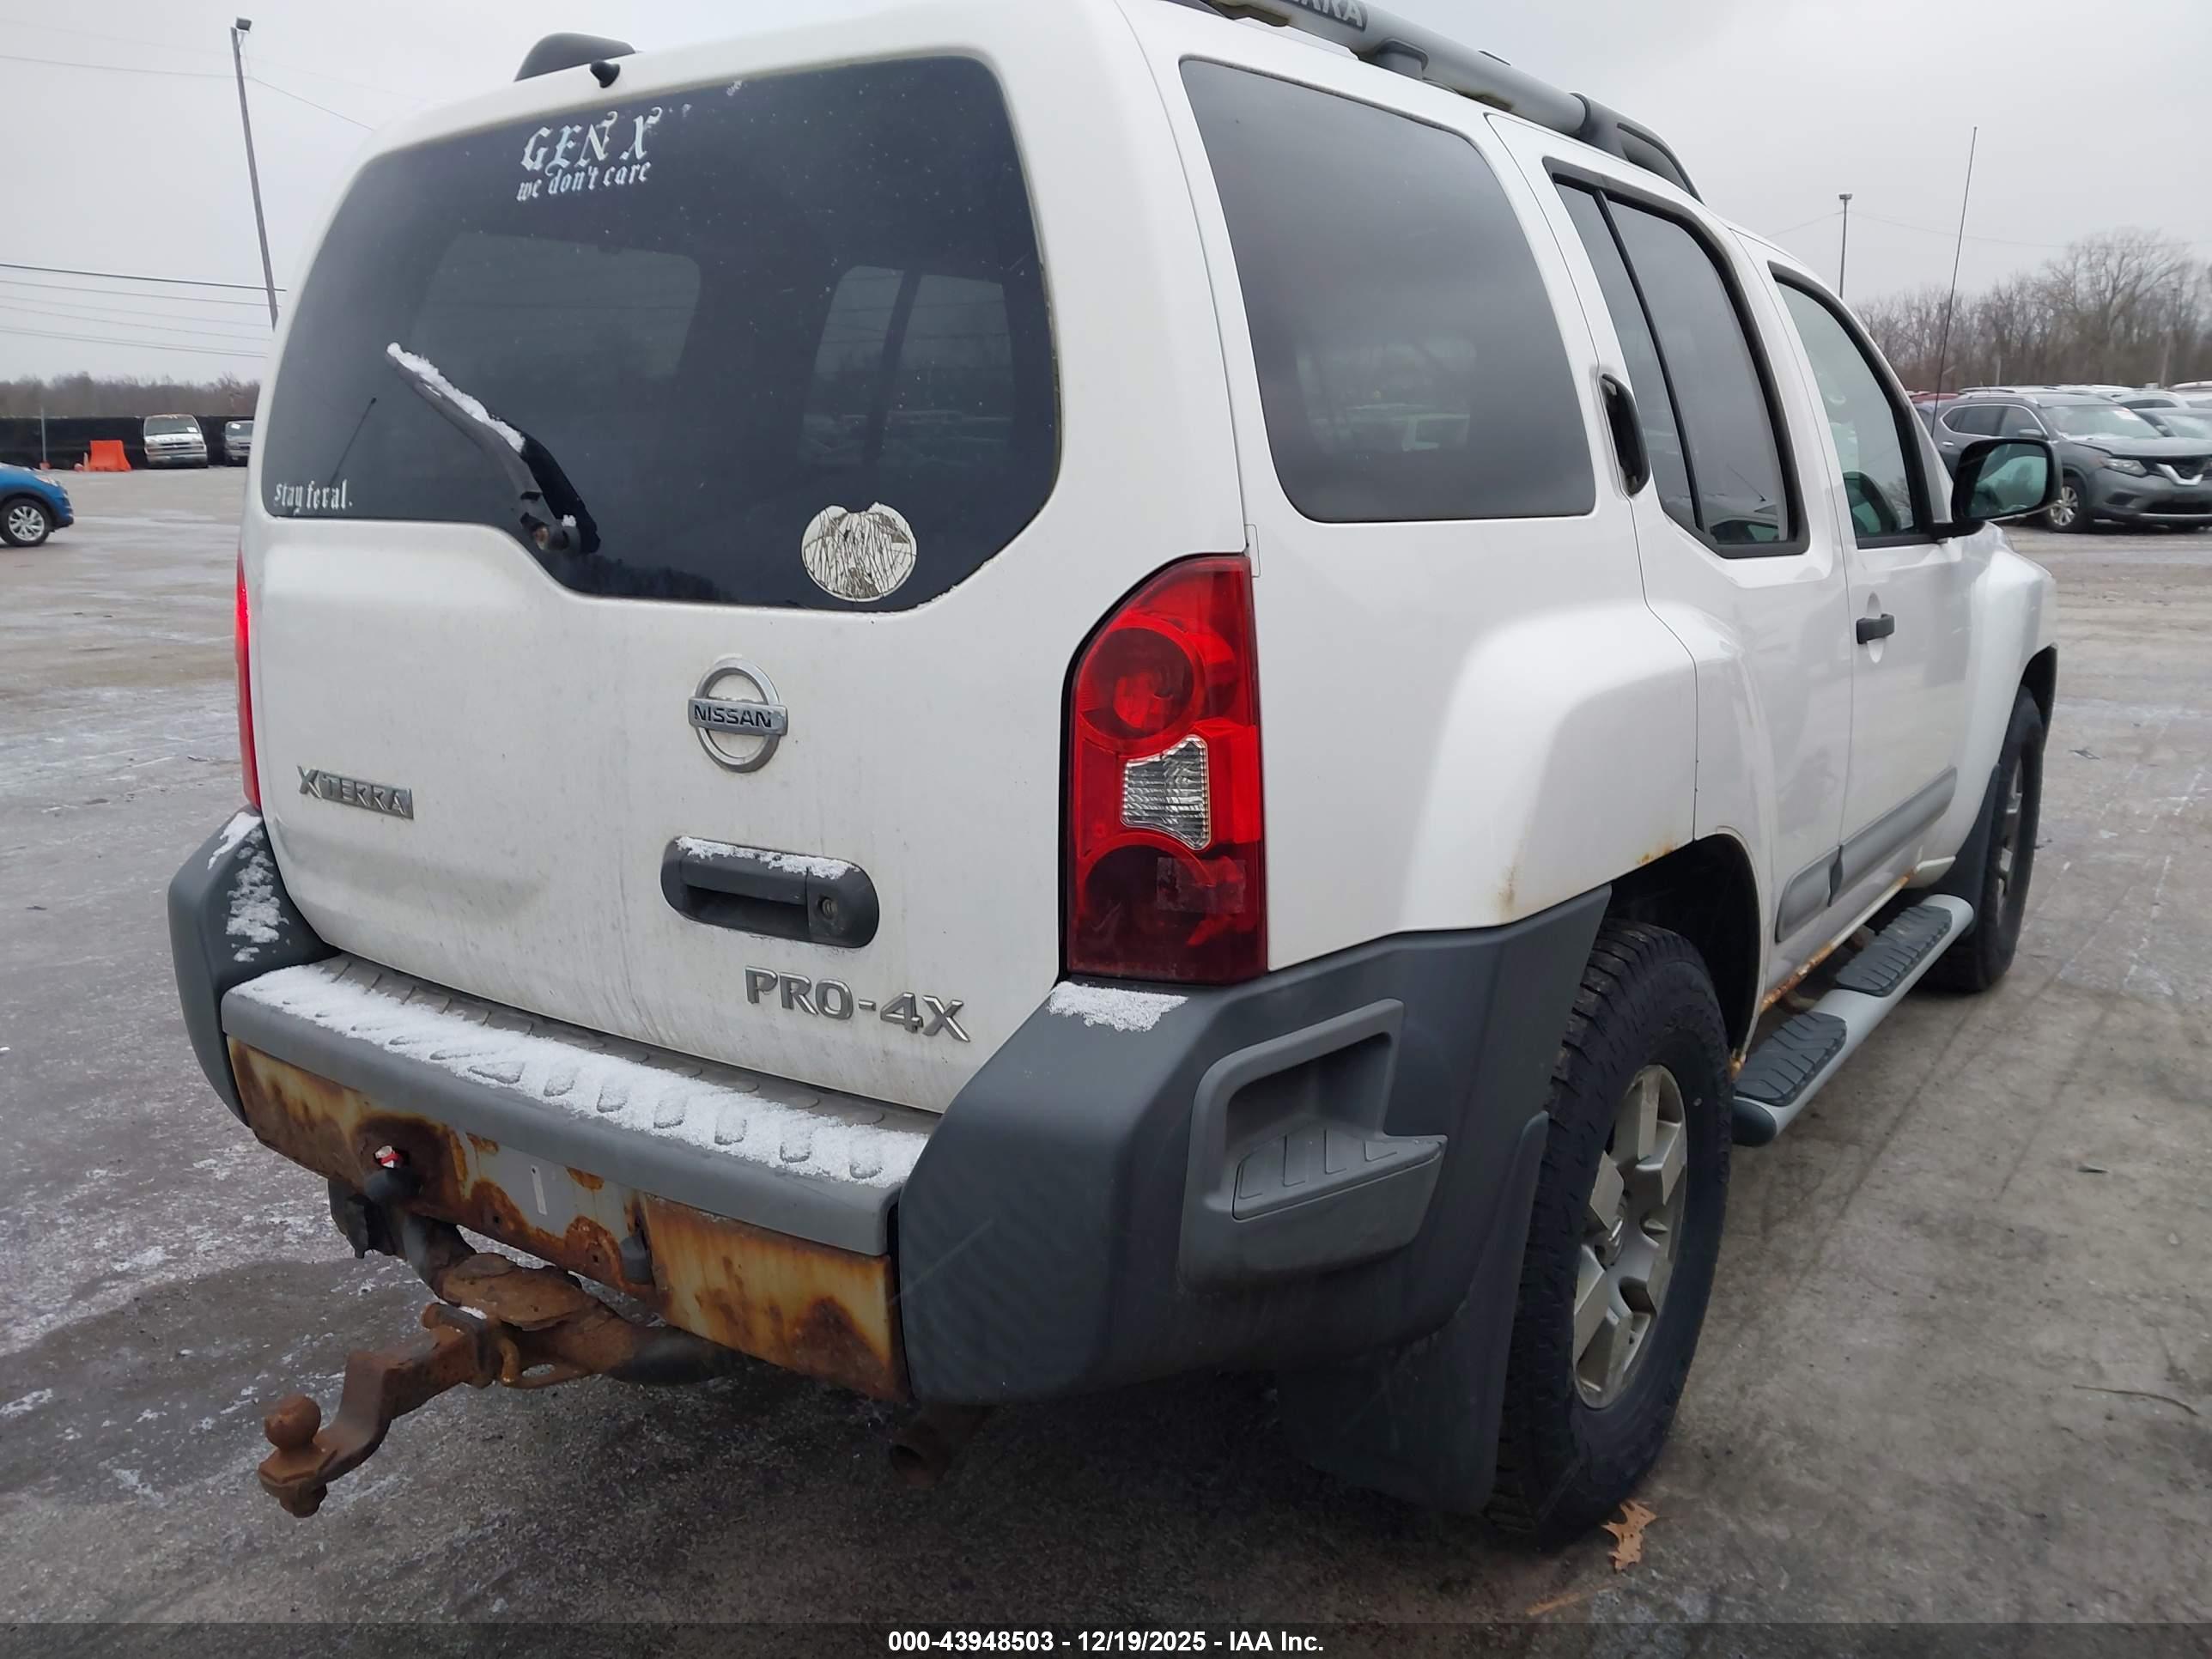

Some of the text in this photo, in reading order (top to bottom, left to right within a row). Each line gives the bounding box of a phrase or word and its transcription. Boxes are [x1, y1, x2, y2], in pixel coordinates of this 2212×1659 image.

[520, 106, 663, 176] GEN X
[516, 161, 652, 202] we don't care
[274, 483, 303, 515] stay
[694, 704, 772, 728] NISSAN
[297, 765, 407, 816] XTERRA
[745, 965, 970, 1042] PRO-4X
